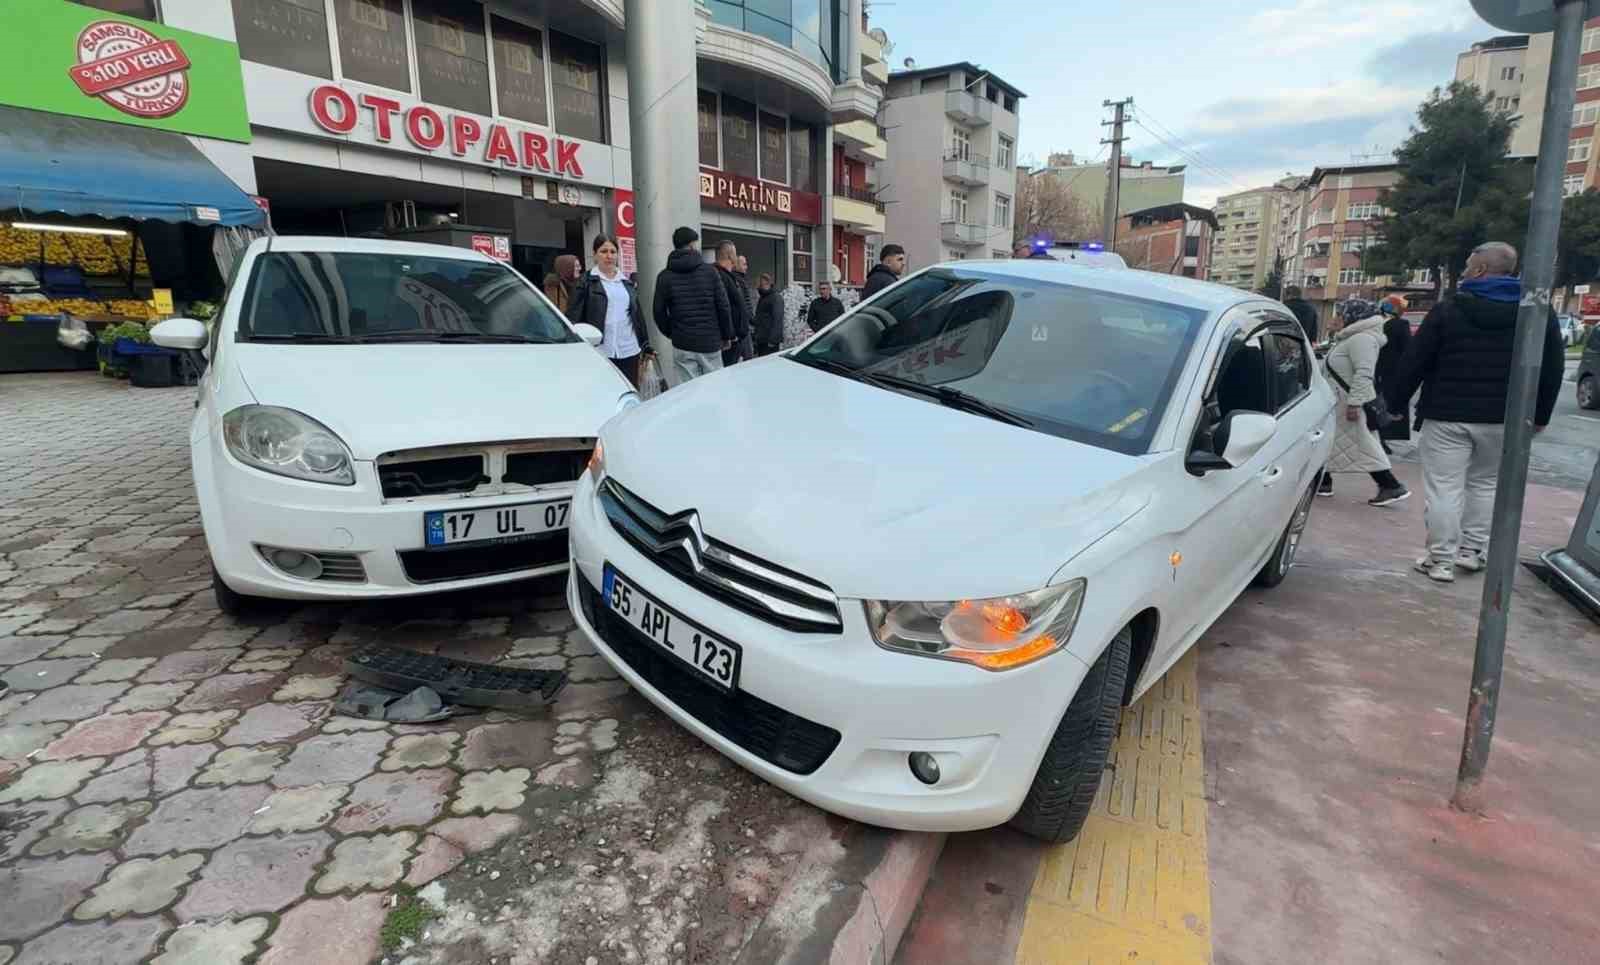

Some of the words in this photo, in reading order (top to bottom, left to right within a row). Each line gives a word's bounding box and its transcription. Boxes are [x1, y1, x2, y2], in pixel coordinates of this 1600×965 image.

[82, 25, 153, 52] SAMSUN
[81, 60, 129, 83] %100
[310, 84, 585, 179] OTOPARK
[717, 178, 775, 206] PLATİN
[447, 513, 475, 539] 17
[496, 509, 525, 534] UL
[544, 502, 570, 528] 07
[612, 578, 632, 616] 55
[641, 601, 675, 649] APL
[692, 632, 733, 681] 123
